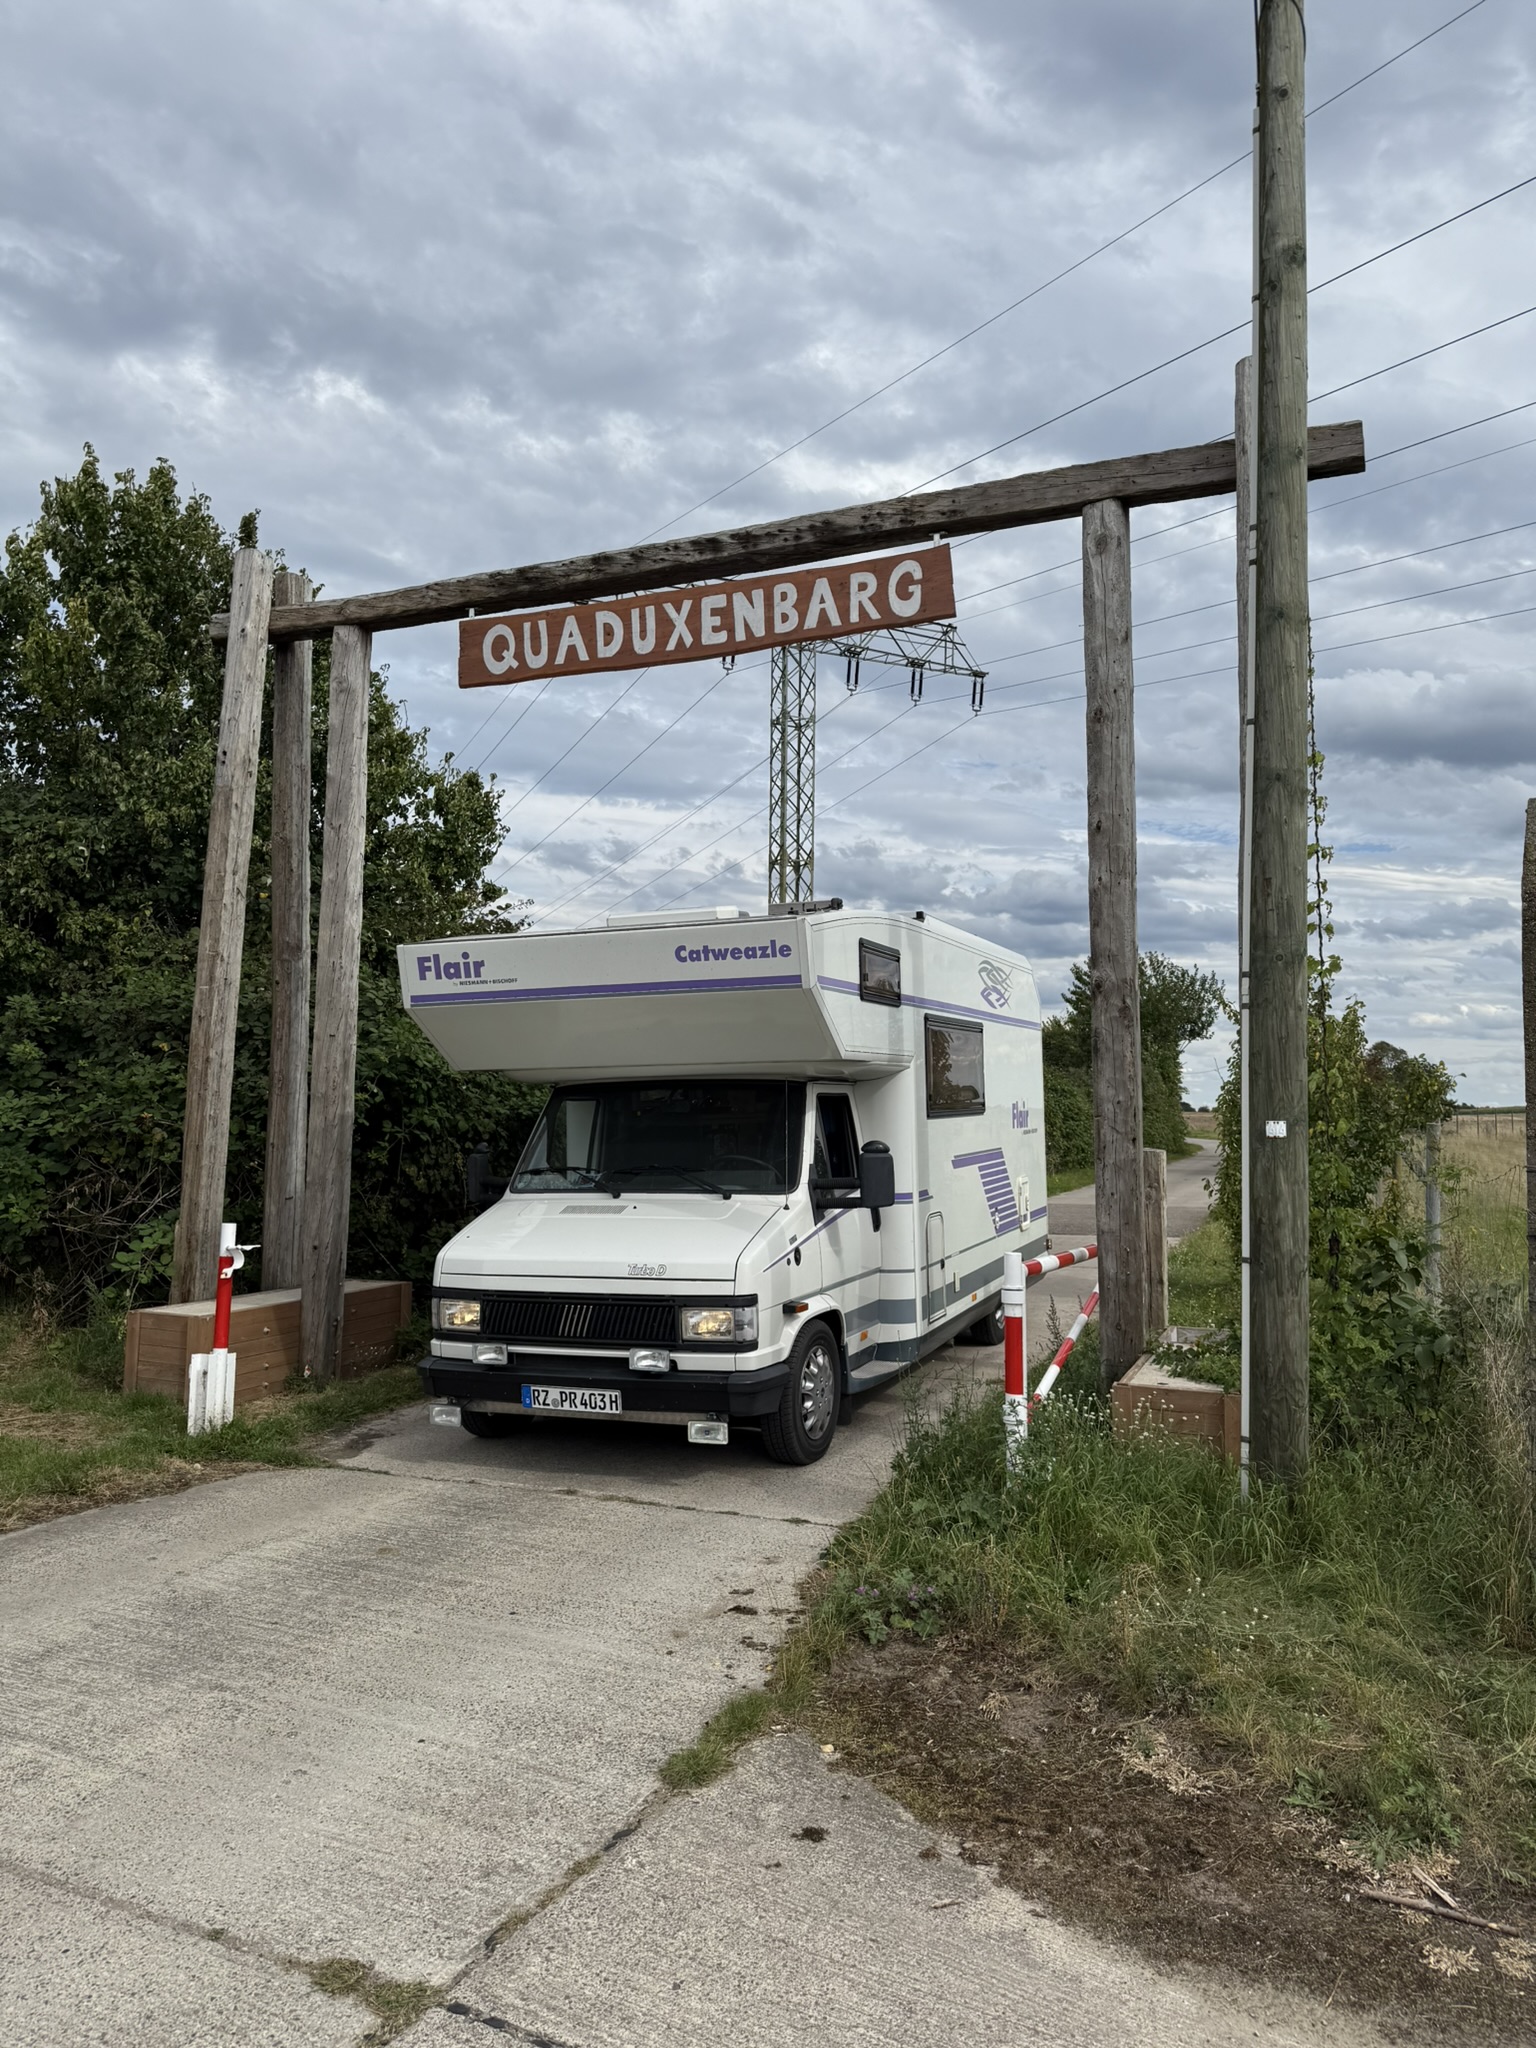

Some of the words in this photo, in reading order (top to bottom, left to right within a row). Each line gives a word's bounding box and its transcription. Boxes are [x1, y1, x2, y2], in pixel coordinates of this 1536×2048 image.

[482, 560, 923, 675] QUADUXENBARG
[674, 939, 792, 963] Catweazle
[416, 951, 485, 981] Flair
[1011, 1100, 1029, 1129] Flair
[532, 1388, 550, 1407] RZ
